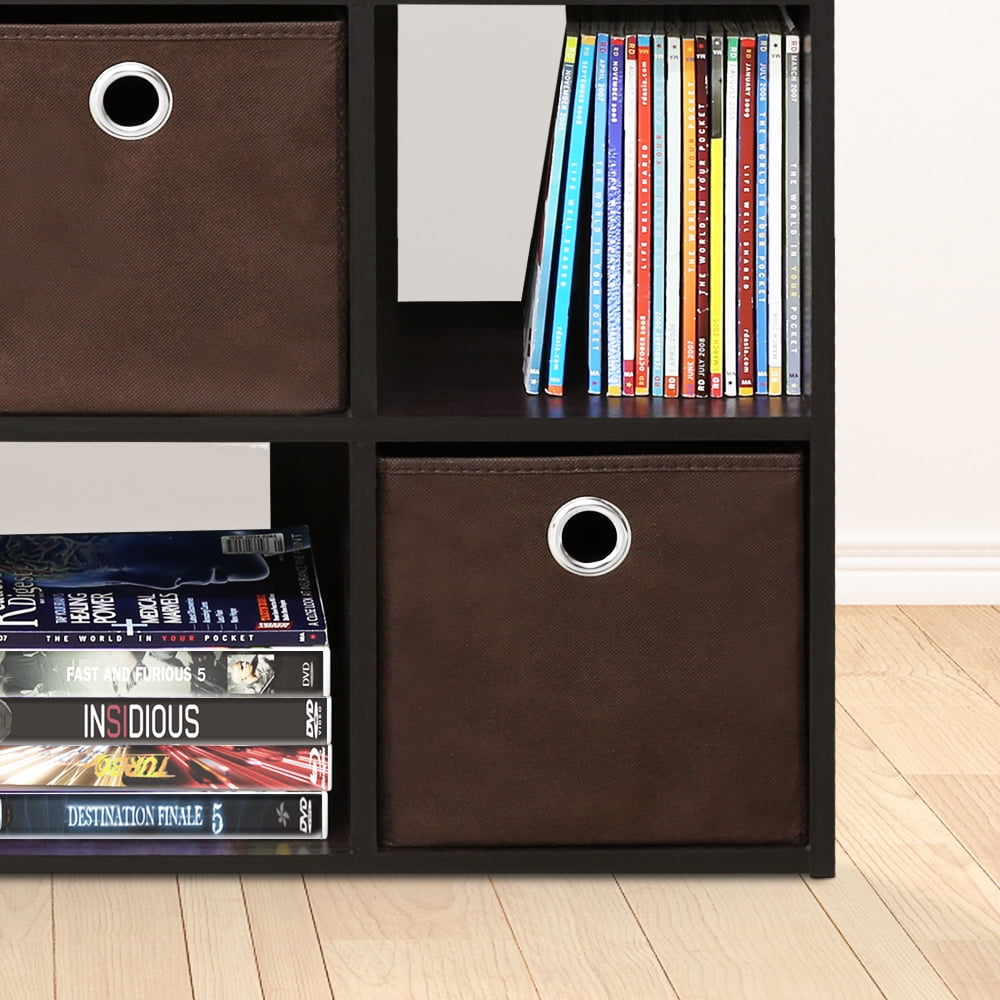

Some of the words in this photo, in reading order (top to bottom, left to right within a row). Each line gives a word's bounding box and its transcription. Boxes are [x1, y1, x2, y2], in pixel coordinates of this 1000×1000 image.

[566, 47, 576, 59] RD
[600, 42, 606, 54] RD
[613, 46, 619, 56] RD
[628, 42, 636, 55] RD
[730, 46, 738, 58] RD
[746, 48, 752, 59] RD
[760, 40, 767, 52] RD
[790, 40, 798, 52] RD
[578, 60, 588, 103] SEPTEMBER
[598, 58, 606, 81] APRIL
[640, 60, 648, 106] rdasia.com
[560, 70, 572, 110] NOVEMBER
[698, 104, 706, 151] POCKET
[569, 162, 578, 190] LIFE
[594, 161, 602, 182] THE
[688, 178, 696, 192] IN
[698, 160, 706, 192] YOUR
[594, 192, 602, 232] WORLD
[698, 200, 706, 214] IN
[759, 193, 766, 206] IN
[566, 200, 574, 230] WELL
[640, 202, 648, 234] WELL
[688, 200, 696, 242] WORLD
[592, 242, 600, 254] IN
[640, 242, 648, 270] LIFE
[698, 222, 706, 264] WORLD
[790, 244, 797, 256] IN
[560, 240, 571, 287] SHARED
[592, 264, 600, 295] YOUR
[698, 272, 706, 295] THE
[758, 256, 766, 303] POCKET
[790, 266, 798, 297] YOUR
[591, 304, 600, 351] POCKET
[790, 306, 798, 353] POCKET
[552, 326, 562, 371] rdasia.com
[638, 337, 646, 372] OCTOBER
[698, 338, 706, 357] 2008
[712, 339, 720, 366] MARCH
[639, 376, 645, 386] RD
[698, 358, 706, 376] JULY
[654, 376, 660, 388] RD
[668, 376, 676, 390] RD
[698, 379, 706, 392] RD
[712, 376, 720, 389] RD
[8, 572, 42, 606] Digest
[67, 592, 91, 624] HEALING
[90, 592, 117, 624] POWER
[138, 594, 160, 624] MEDICAL
[160, 592, 182, 624] MARVELS
[138, 634, 152, 642] IN
[204, 634, 256, 642] POCKET
[66, 666, 99, 682] FAST
[104, 666, 131, 682] AND
[135, 666, 192, 682] FURIOUS
[198, 668, 206, 682] 5
[302, 662, 310, 687] DVD
[84, 704, 200, 738] INSIDIOUS
[306, 698, 314, 738] DVD
[91, 752, 176, 778] TURBO
[67, 805, 154, 827] DESTINATION
[158, 805, 204, 826] FINALE
[212, 802, 225, 835] 5
[300, 796, 308, 834] DVD
